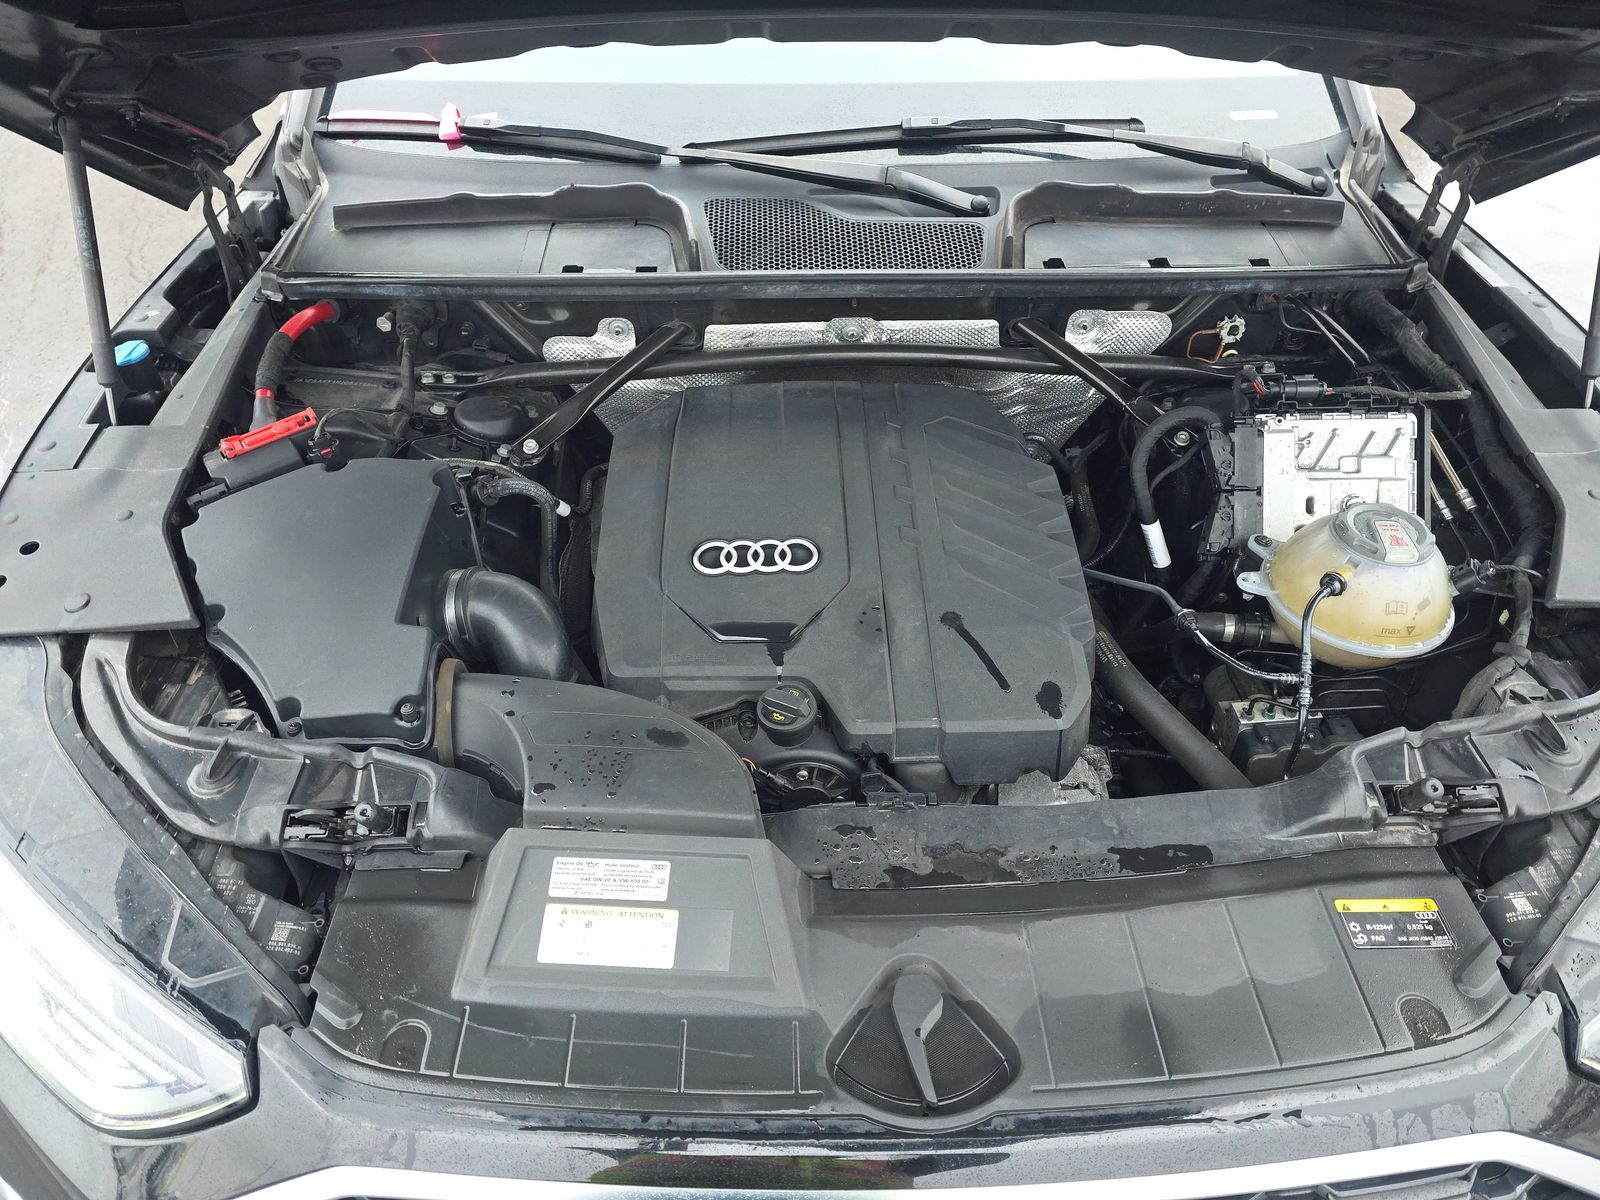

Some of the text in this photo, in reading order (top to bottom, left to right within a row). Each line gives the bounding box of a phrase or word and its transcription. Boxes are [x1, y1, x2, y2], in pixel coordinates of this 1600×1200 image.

[1380, 626, 1402, 636] max
[571, 908, 665, 919] WARNING ATTENTION
